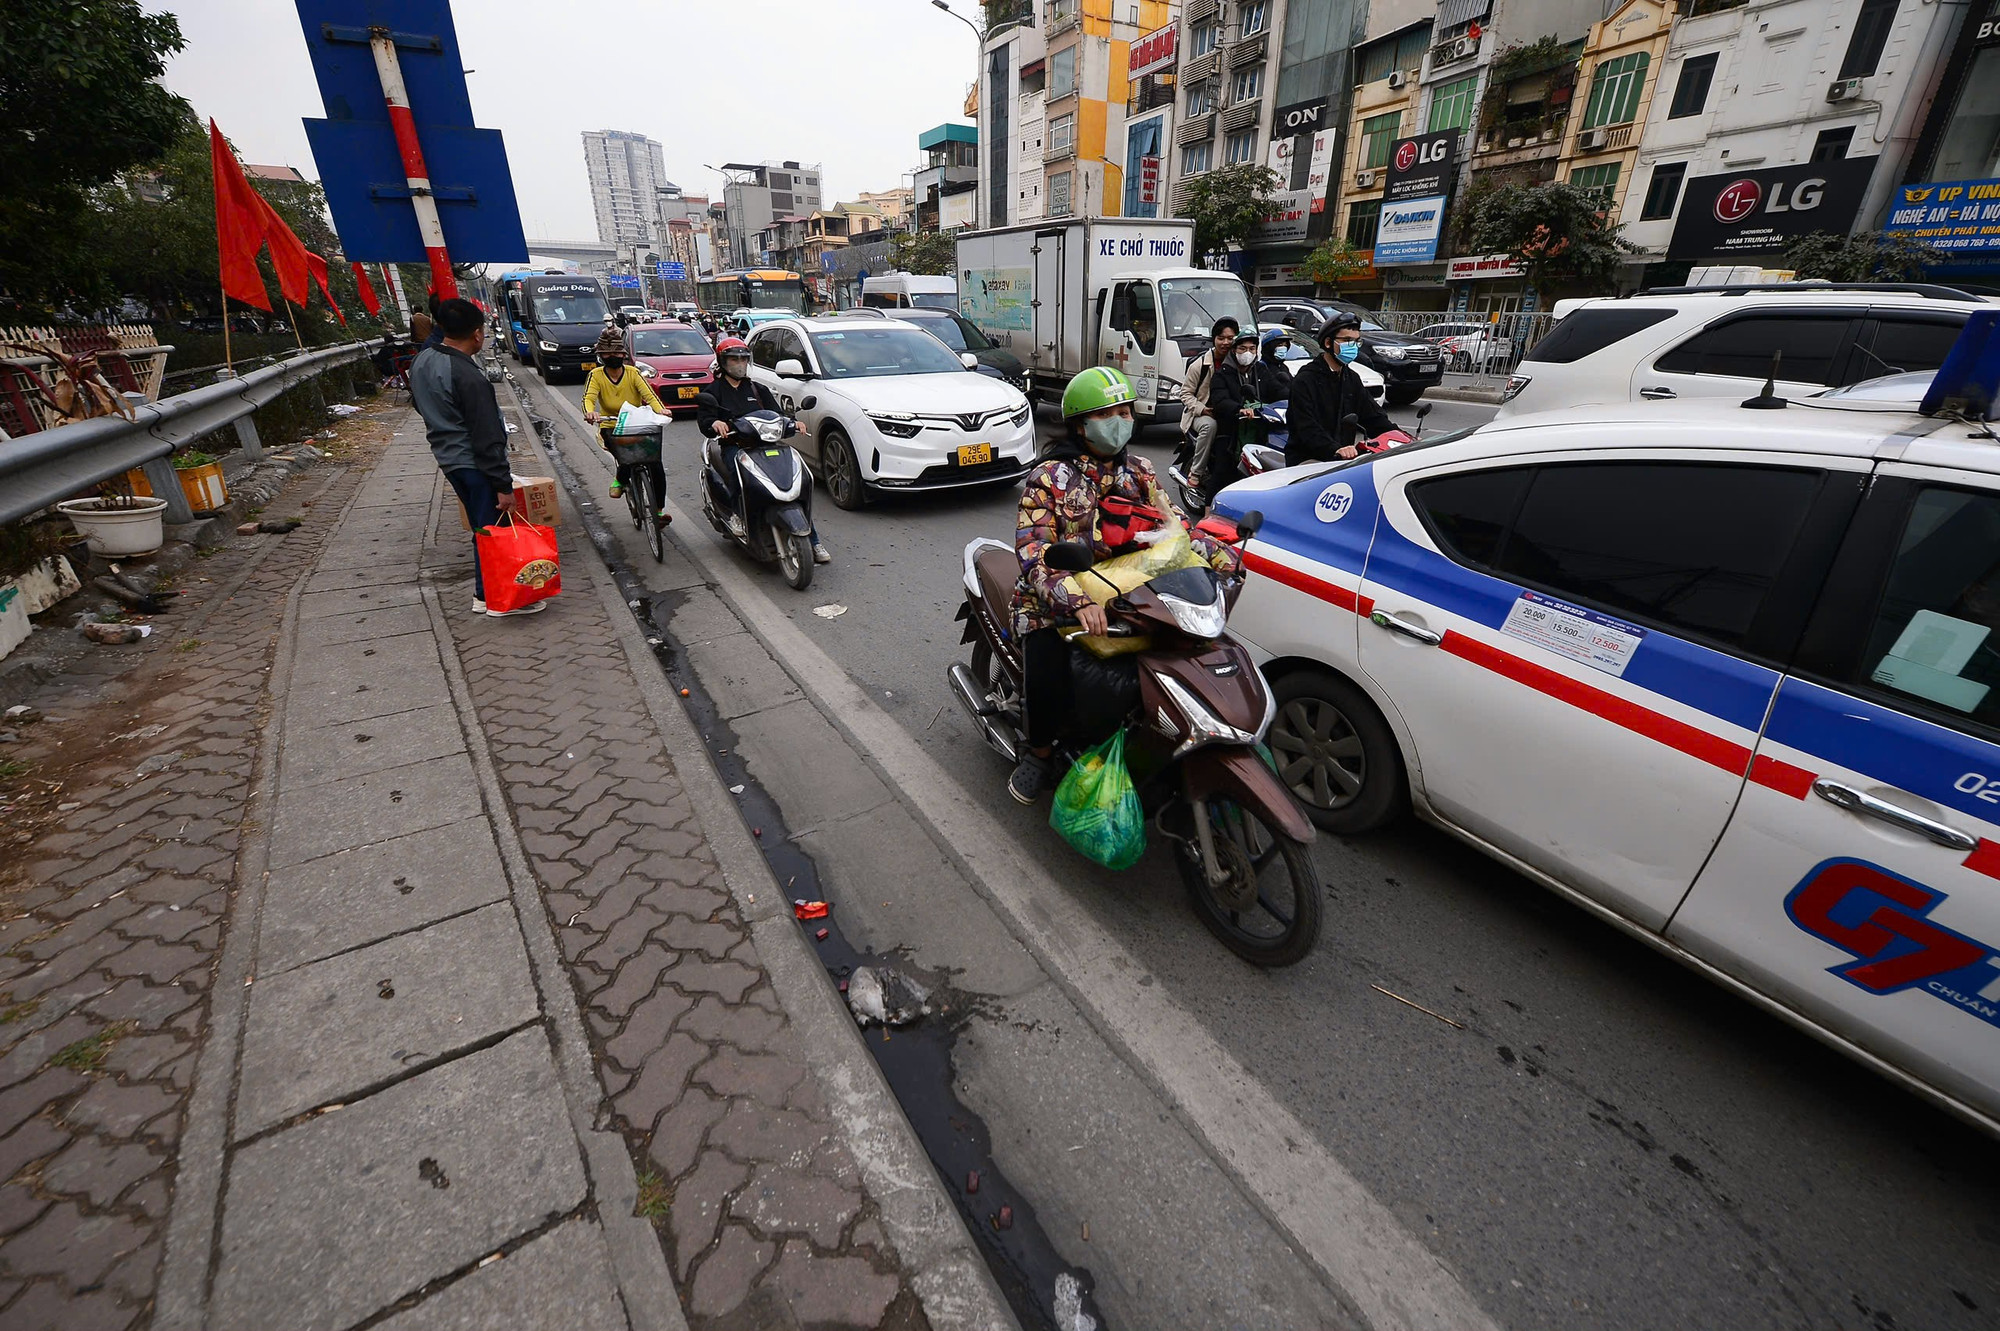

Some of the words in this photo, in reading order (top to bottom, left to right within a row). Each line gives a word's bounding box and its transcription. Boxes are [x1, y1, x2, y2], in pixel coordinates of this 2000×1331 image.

[1419, 139, 1448, 164] LG
[1764, 178, 1826, 213] LG
[1939, 187, 1963, 201] VP
[1394, 210, 1436, 224] DAIKIN
[1891, 205, 1927, 226] NGHỆ
[1926, 207, 1949, 223] AN
[1914, 225, 1951, 237] CHUYỂN
[1953, 225, 1978, 236] PHÁT
[1100, 239, 1115, 256] XE
[1120, 232, 1144, 256] CHỞ
[1149, 235, 1184, 256] THUỐC
[1933, 239, 1953, 248] 0328
[1453, 262, 1475, 272] CAMERA
[968, 444, 981, 454] 29E
[962, 453, 988, 464] 045.90
[1319, 492, 1350, 513] 4051
[1523, 607, 1546, 620] 20.000
[1552, 623, 1579, 637] 15.500
[1591, 636, 1619, 651] 12.500
[1786, 858, 1986, 993] G7
